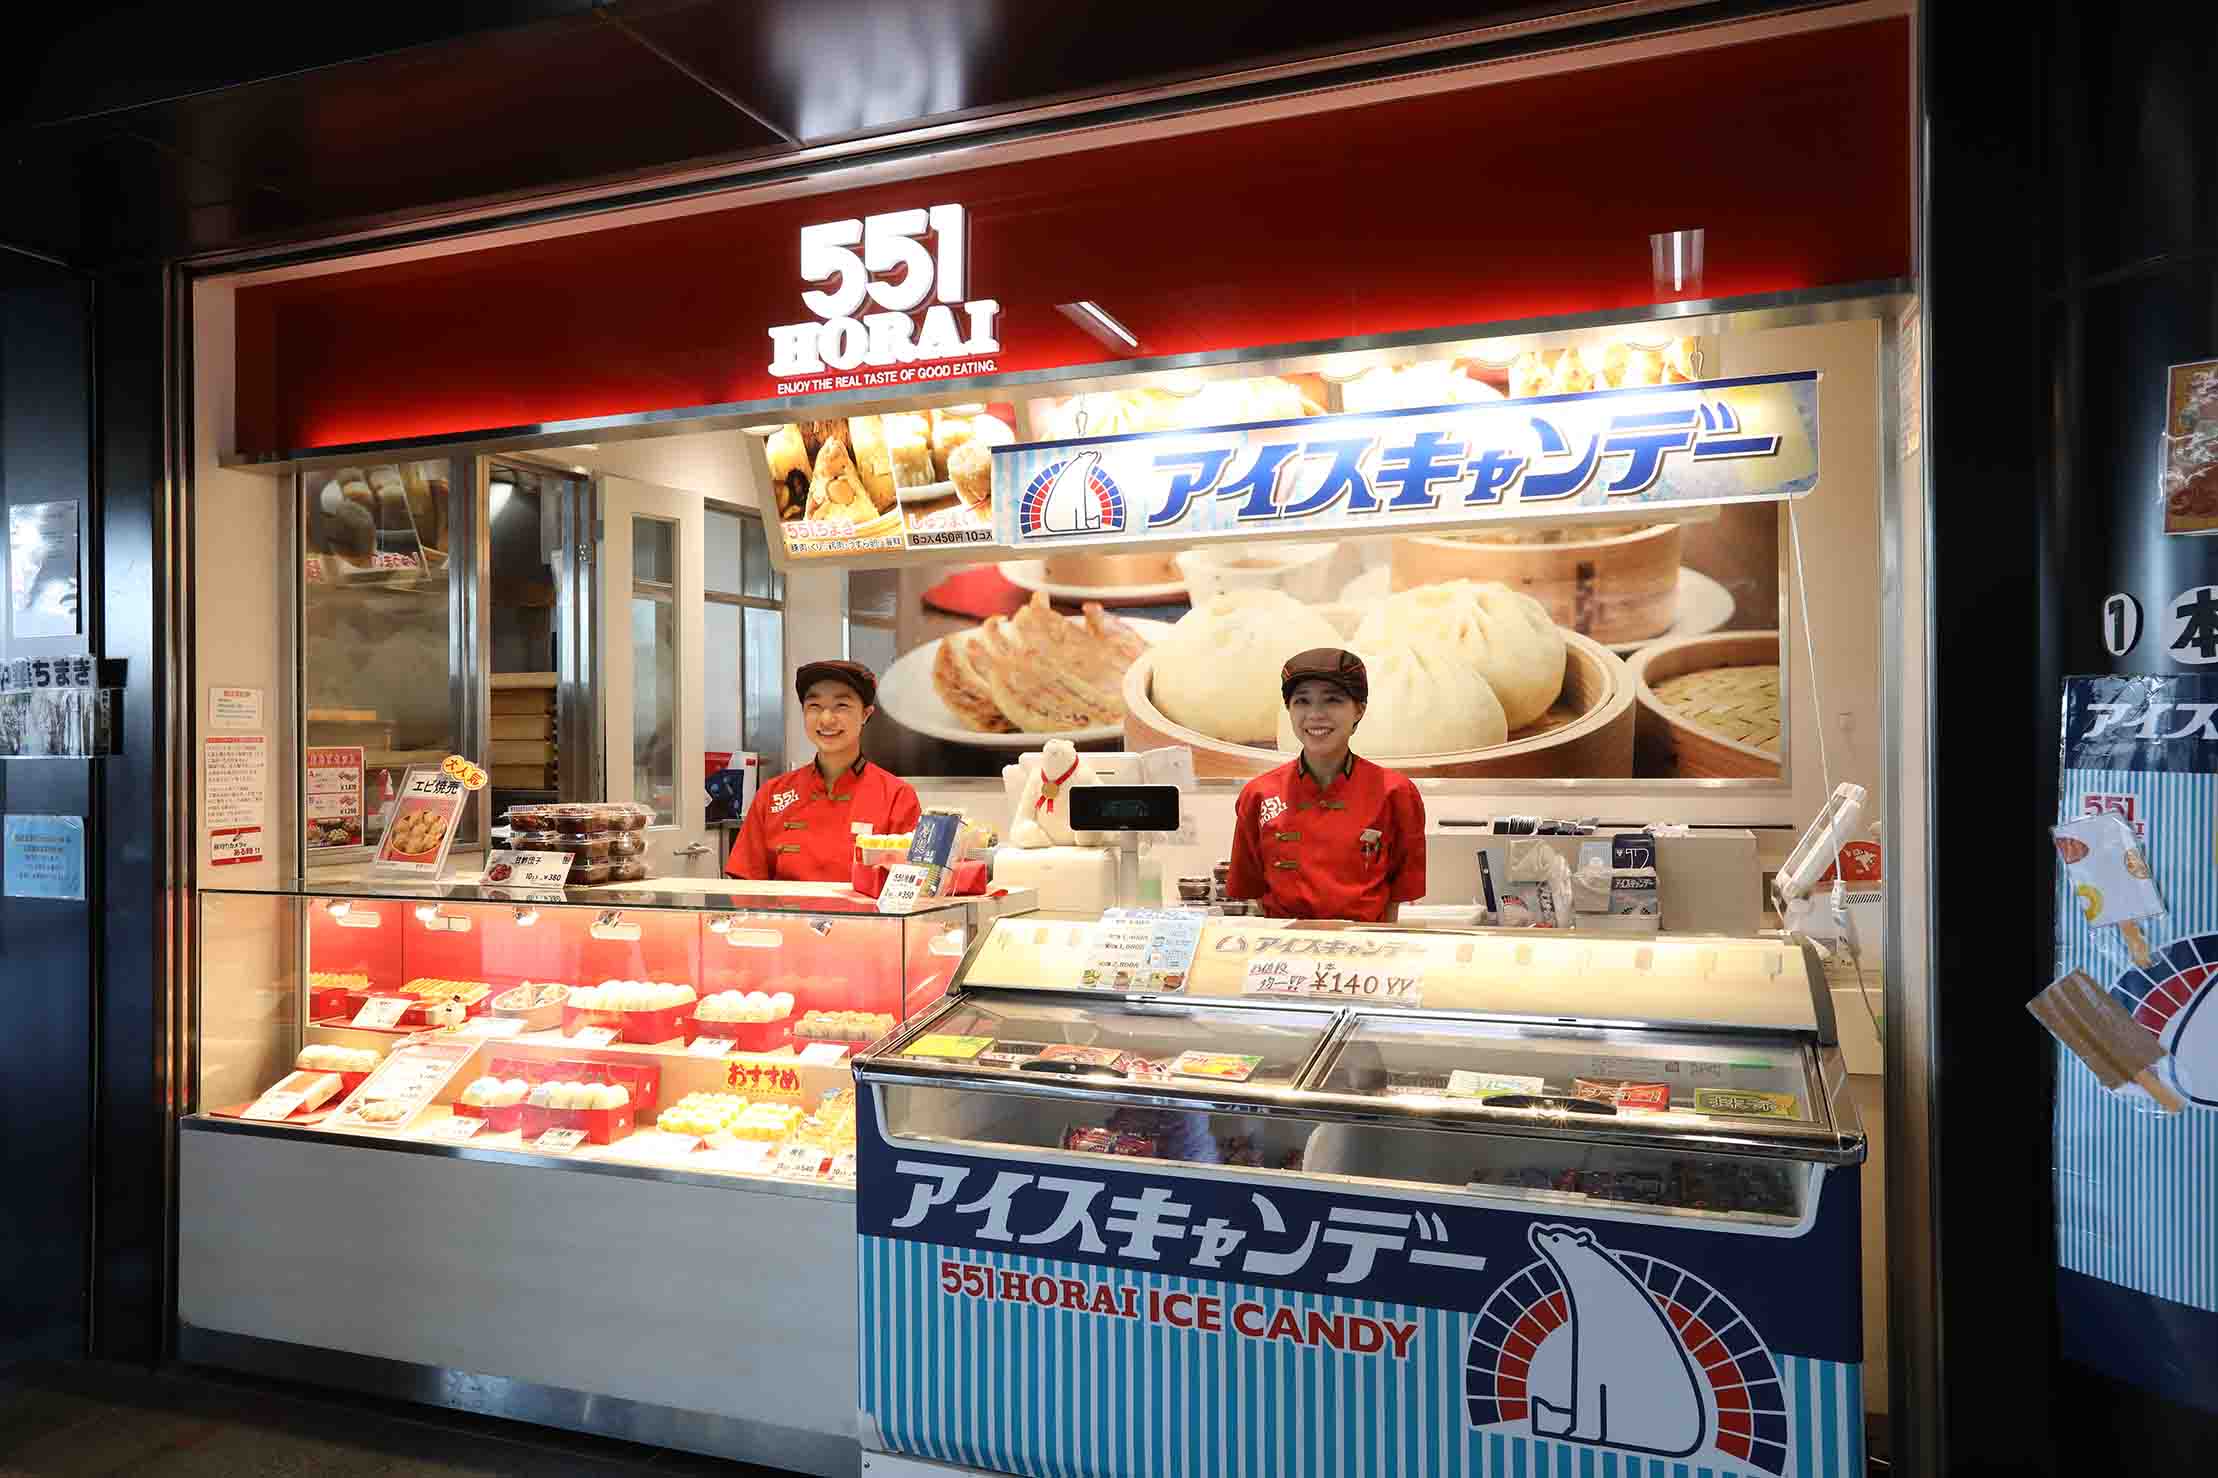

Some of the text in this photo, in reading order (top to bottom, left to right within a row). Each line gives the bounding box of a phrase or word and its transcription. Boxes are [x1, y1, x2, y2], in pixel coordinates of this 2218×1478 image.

[800, 203, 965, 319] 551
[768, 299, 1000, 377] HORAI
[777, 359, 998, 395] ENJOY THE REAL TASTE OF GOOD EATING.
[1147, 400, 1780, 527] アイスキャンデー
[772, 788, 797, 806] 551
[727, 1061, 800, 1090] おすすめ
[890, 1160, 1488, 1284] アイスキャンデー
[1149, 1288, 1222, 1332] ICE
[1233, 1301, 1418, 1359] CANDY
